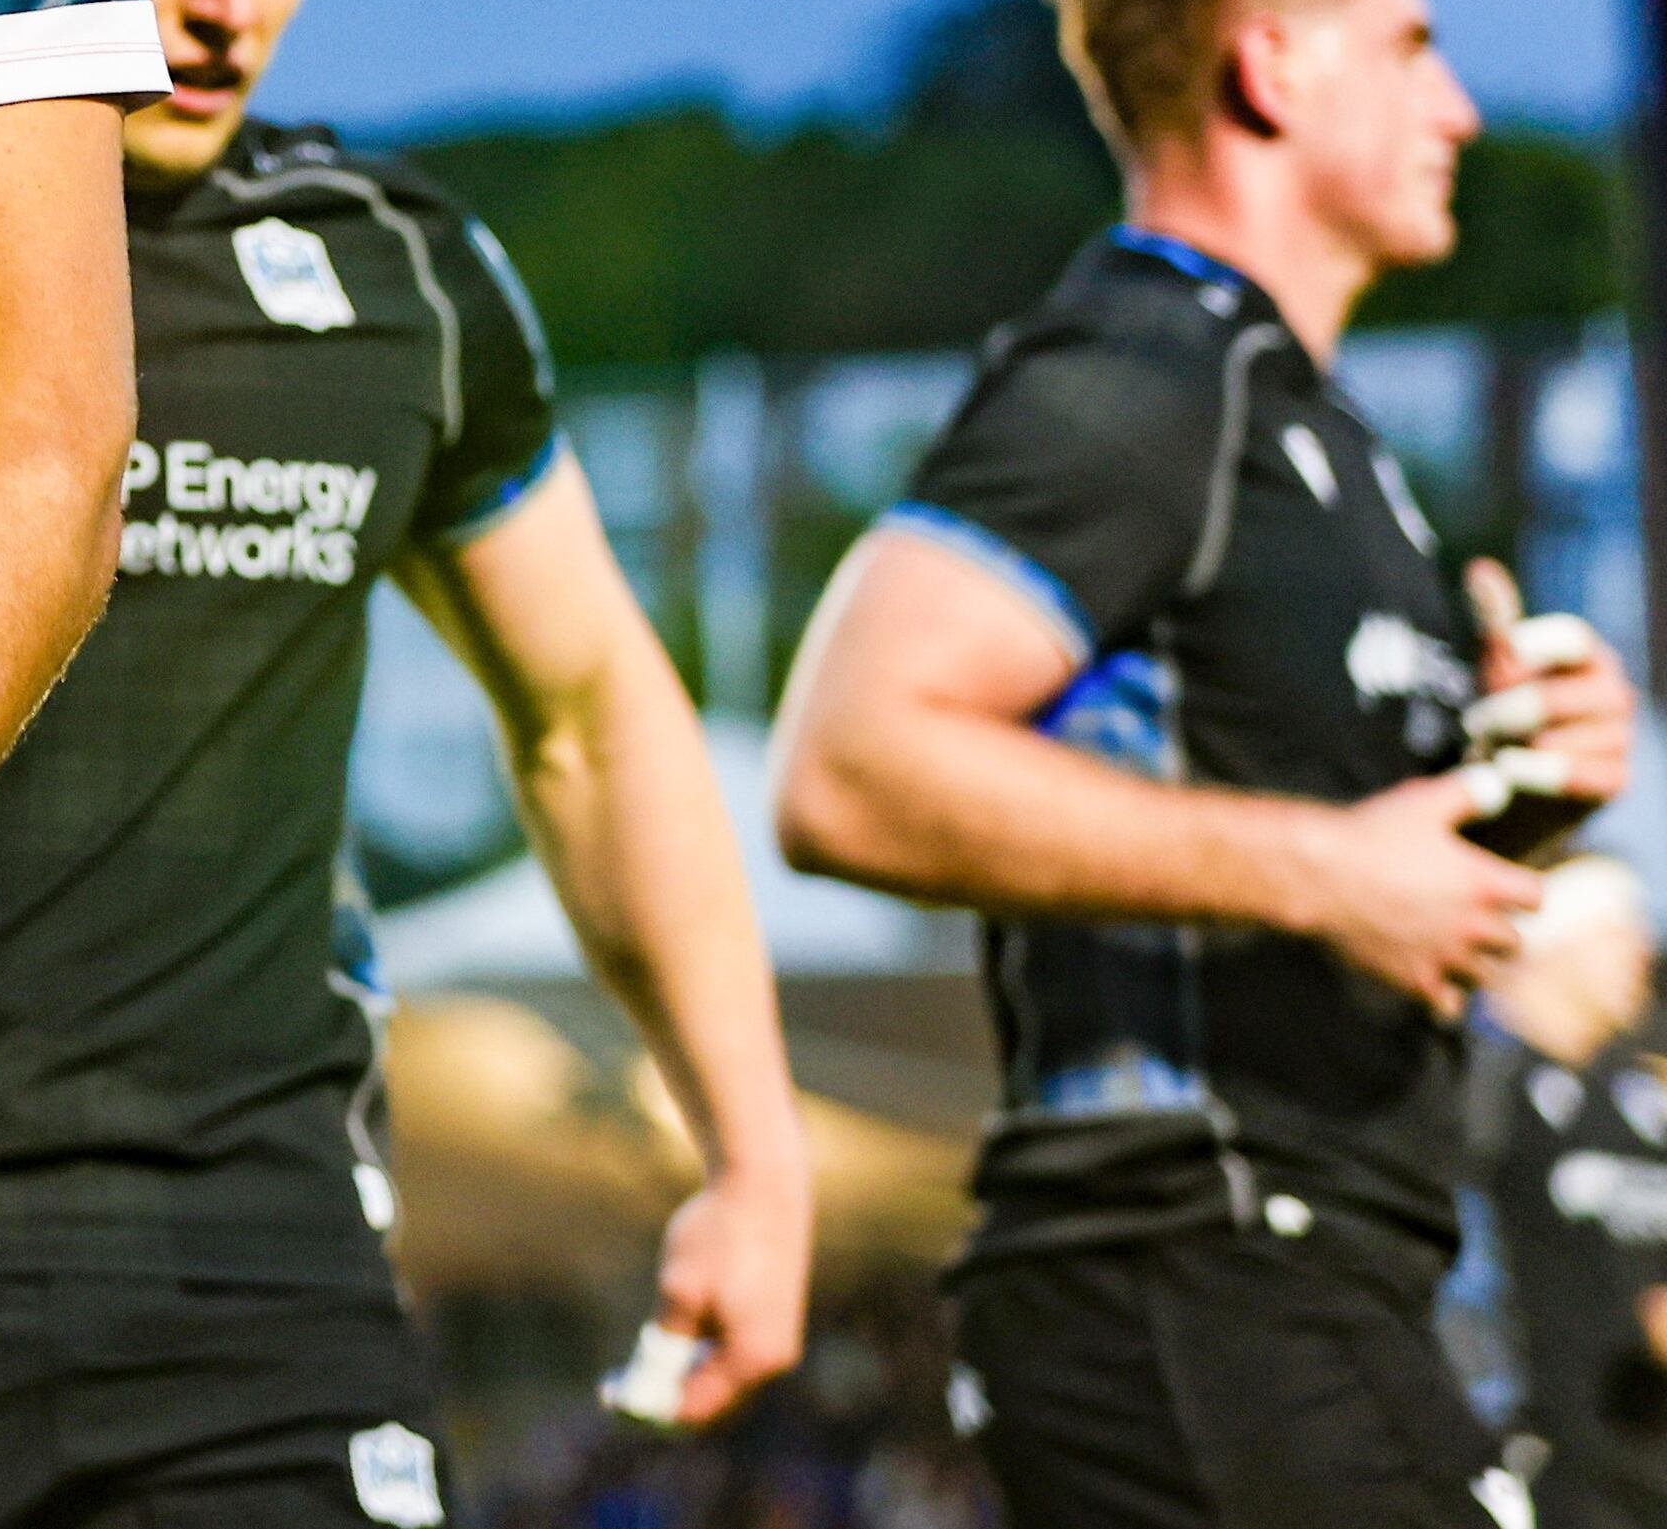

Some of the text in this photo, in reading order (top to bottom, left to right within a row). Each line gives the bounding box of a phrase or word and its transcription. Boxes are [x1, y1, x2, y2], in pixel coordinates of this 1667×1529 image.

[121, 439, 379, 531] P Energy
[120, 510, 358, 585] etworks
